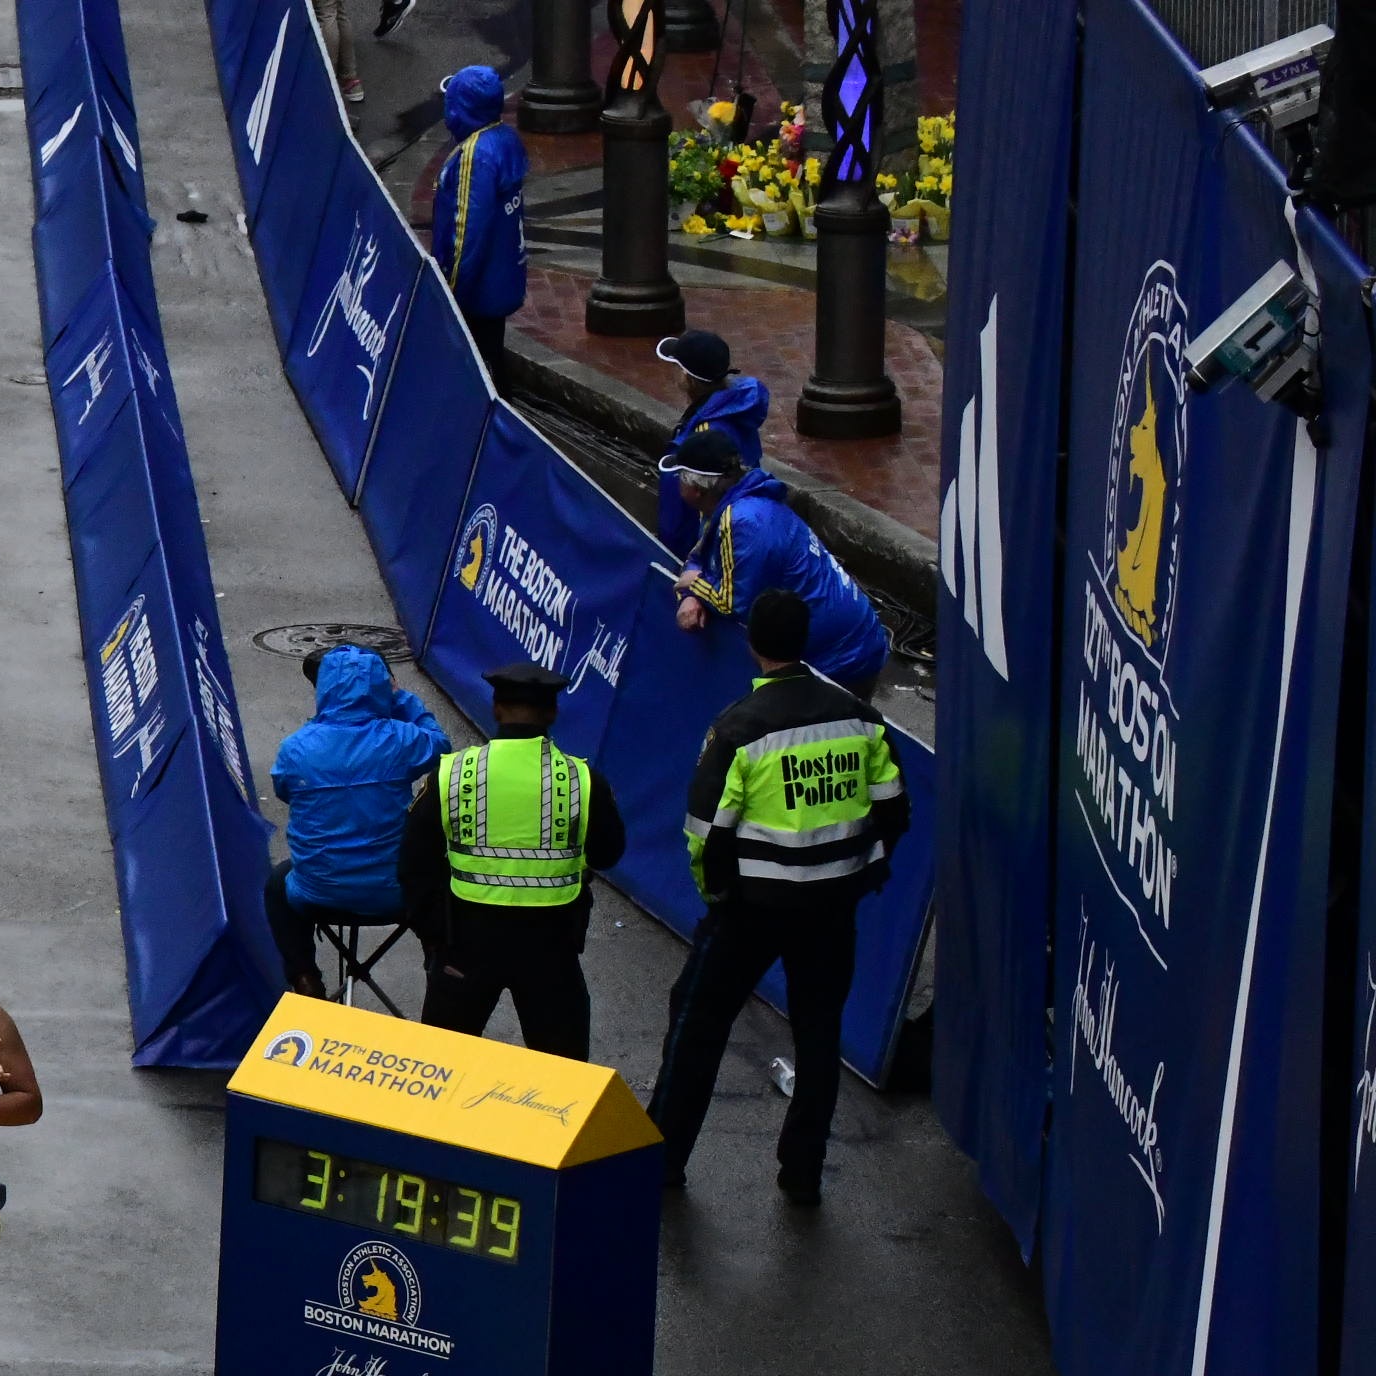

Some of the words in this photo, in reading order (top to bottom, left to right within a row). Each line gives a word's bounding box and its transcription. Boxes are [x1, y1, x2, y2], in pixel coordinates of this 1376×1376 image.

[1272, 61, 1309, 82] LYNX
[499, 525, 529, 580] THE
[520, 548, 572, 627] BOSTON
[482, 570, 562, 672] MARATHON
[461, 757, 474, 838] BOSTON
[554, 759, 567, 842] POLICE
[781, 749, 860, 783] Boston
[785, 777, 858, 810] Police
[1076, 681, 1173, 930] MARATHON
[308, 1055, 443, 1101] MARATHON
[319, 1038, 366, 1057] 127TH
[367, 1050, 454, 1083] BOSTON
[300, 1150, 522, 1259] 3:19:39
[342, 1260, 355, 1305] BOSTON
[353, 1246, 392, 1264] ATHLETIC
[391, 1250, 419, 1325] ASSOCIATION
[304, 1304, 364, 1333] BOSTON
[366, 1321, 451, 1355] MARATHON
